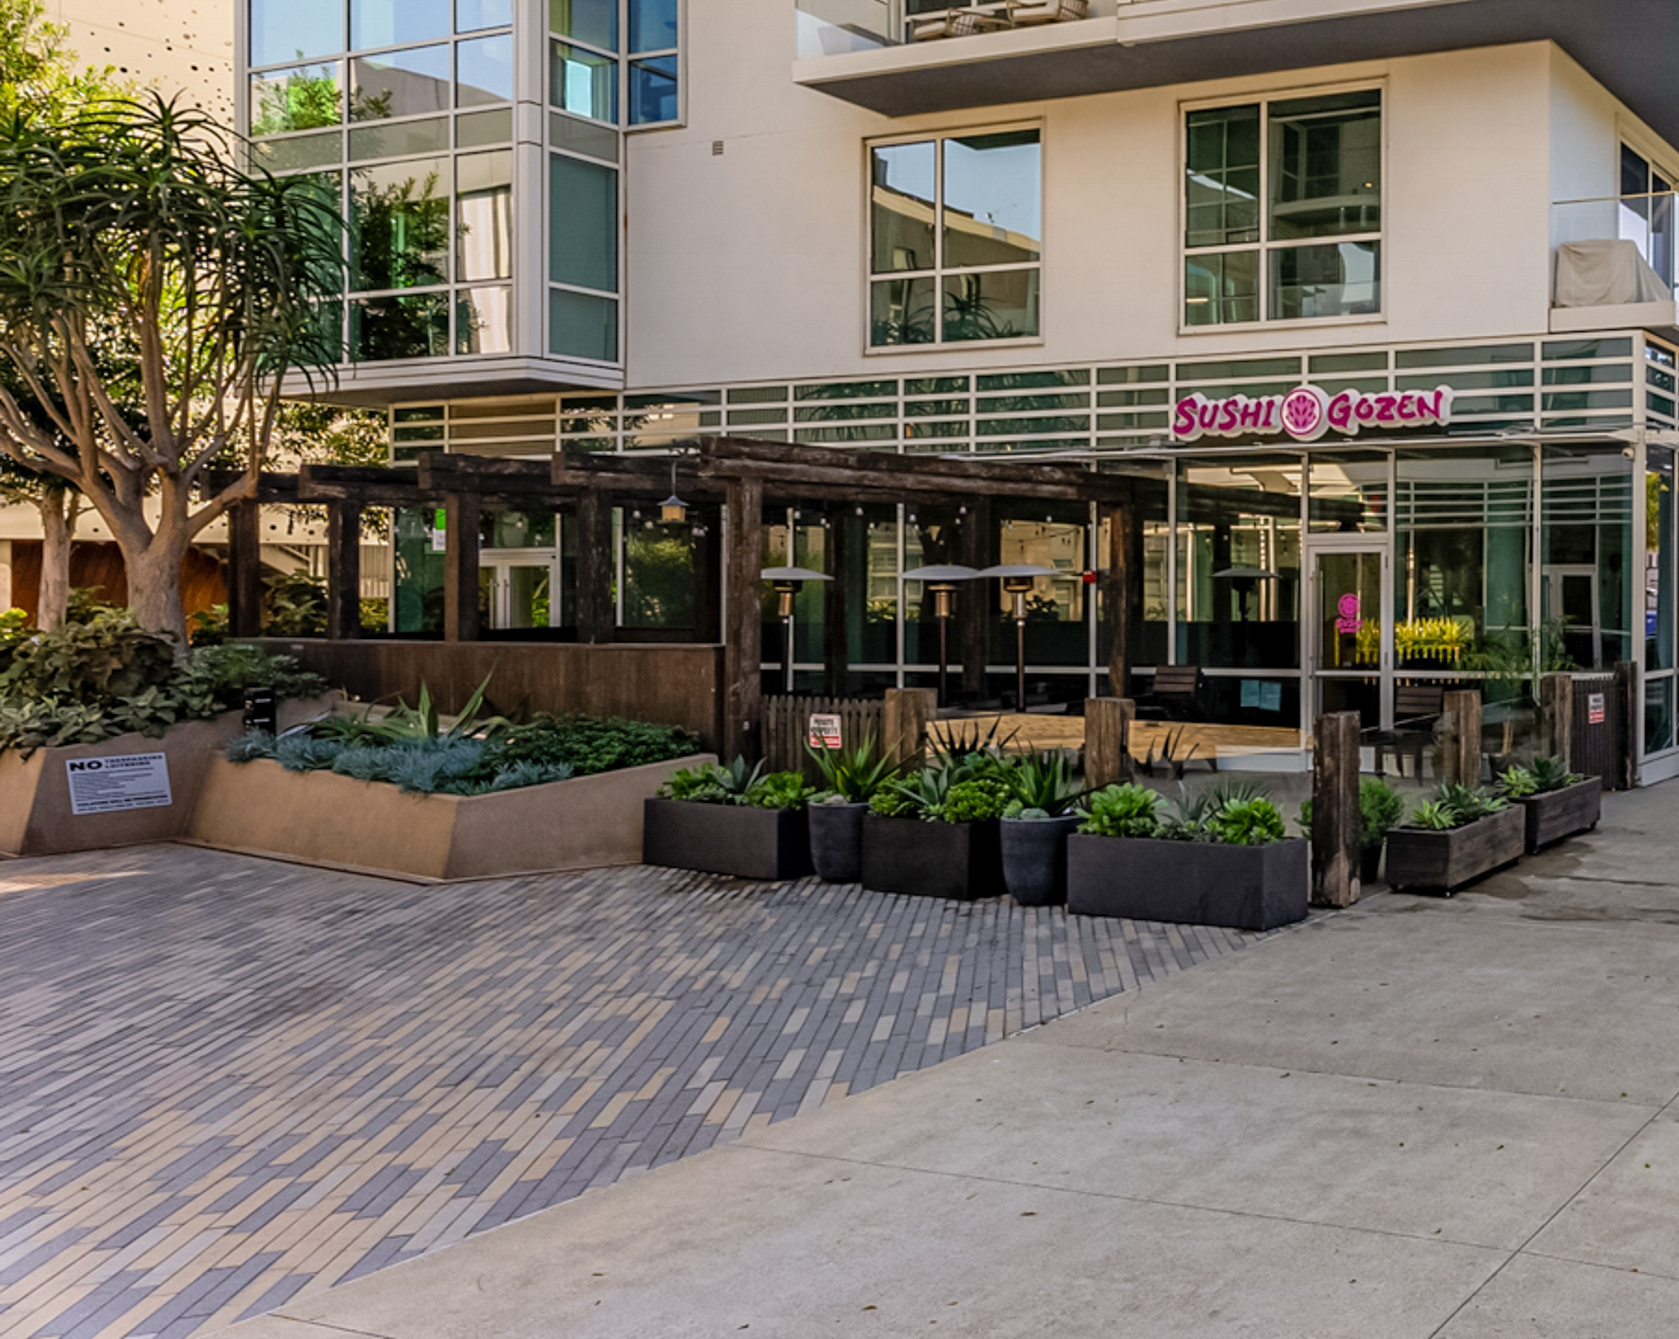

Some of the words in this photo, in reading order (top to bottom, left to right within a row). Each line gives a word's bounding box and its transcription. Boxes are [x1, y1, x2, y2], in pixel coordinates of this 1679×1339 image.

[1173, 397, 1275, 435] SUSHI
[1327, 390, 1444, 428] GOZEN
[69, 760, 102, 772] NO
